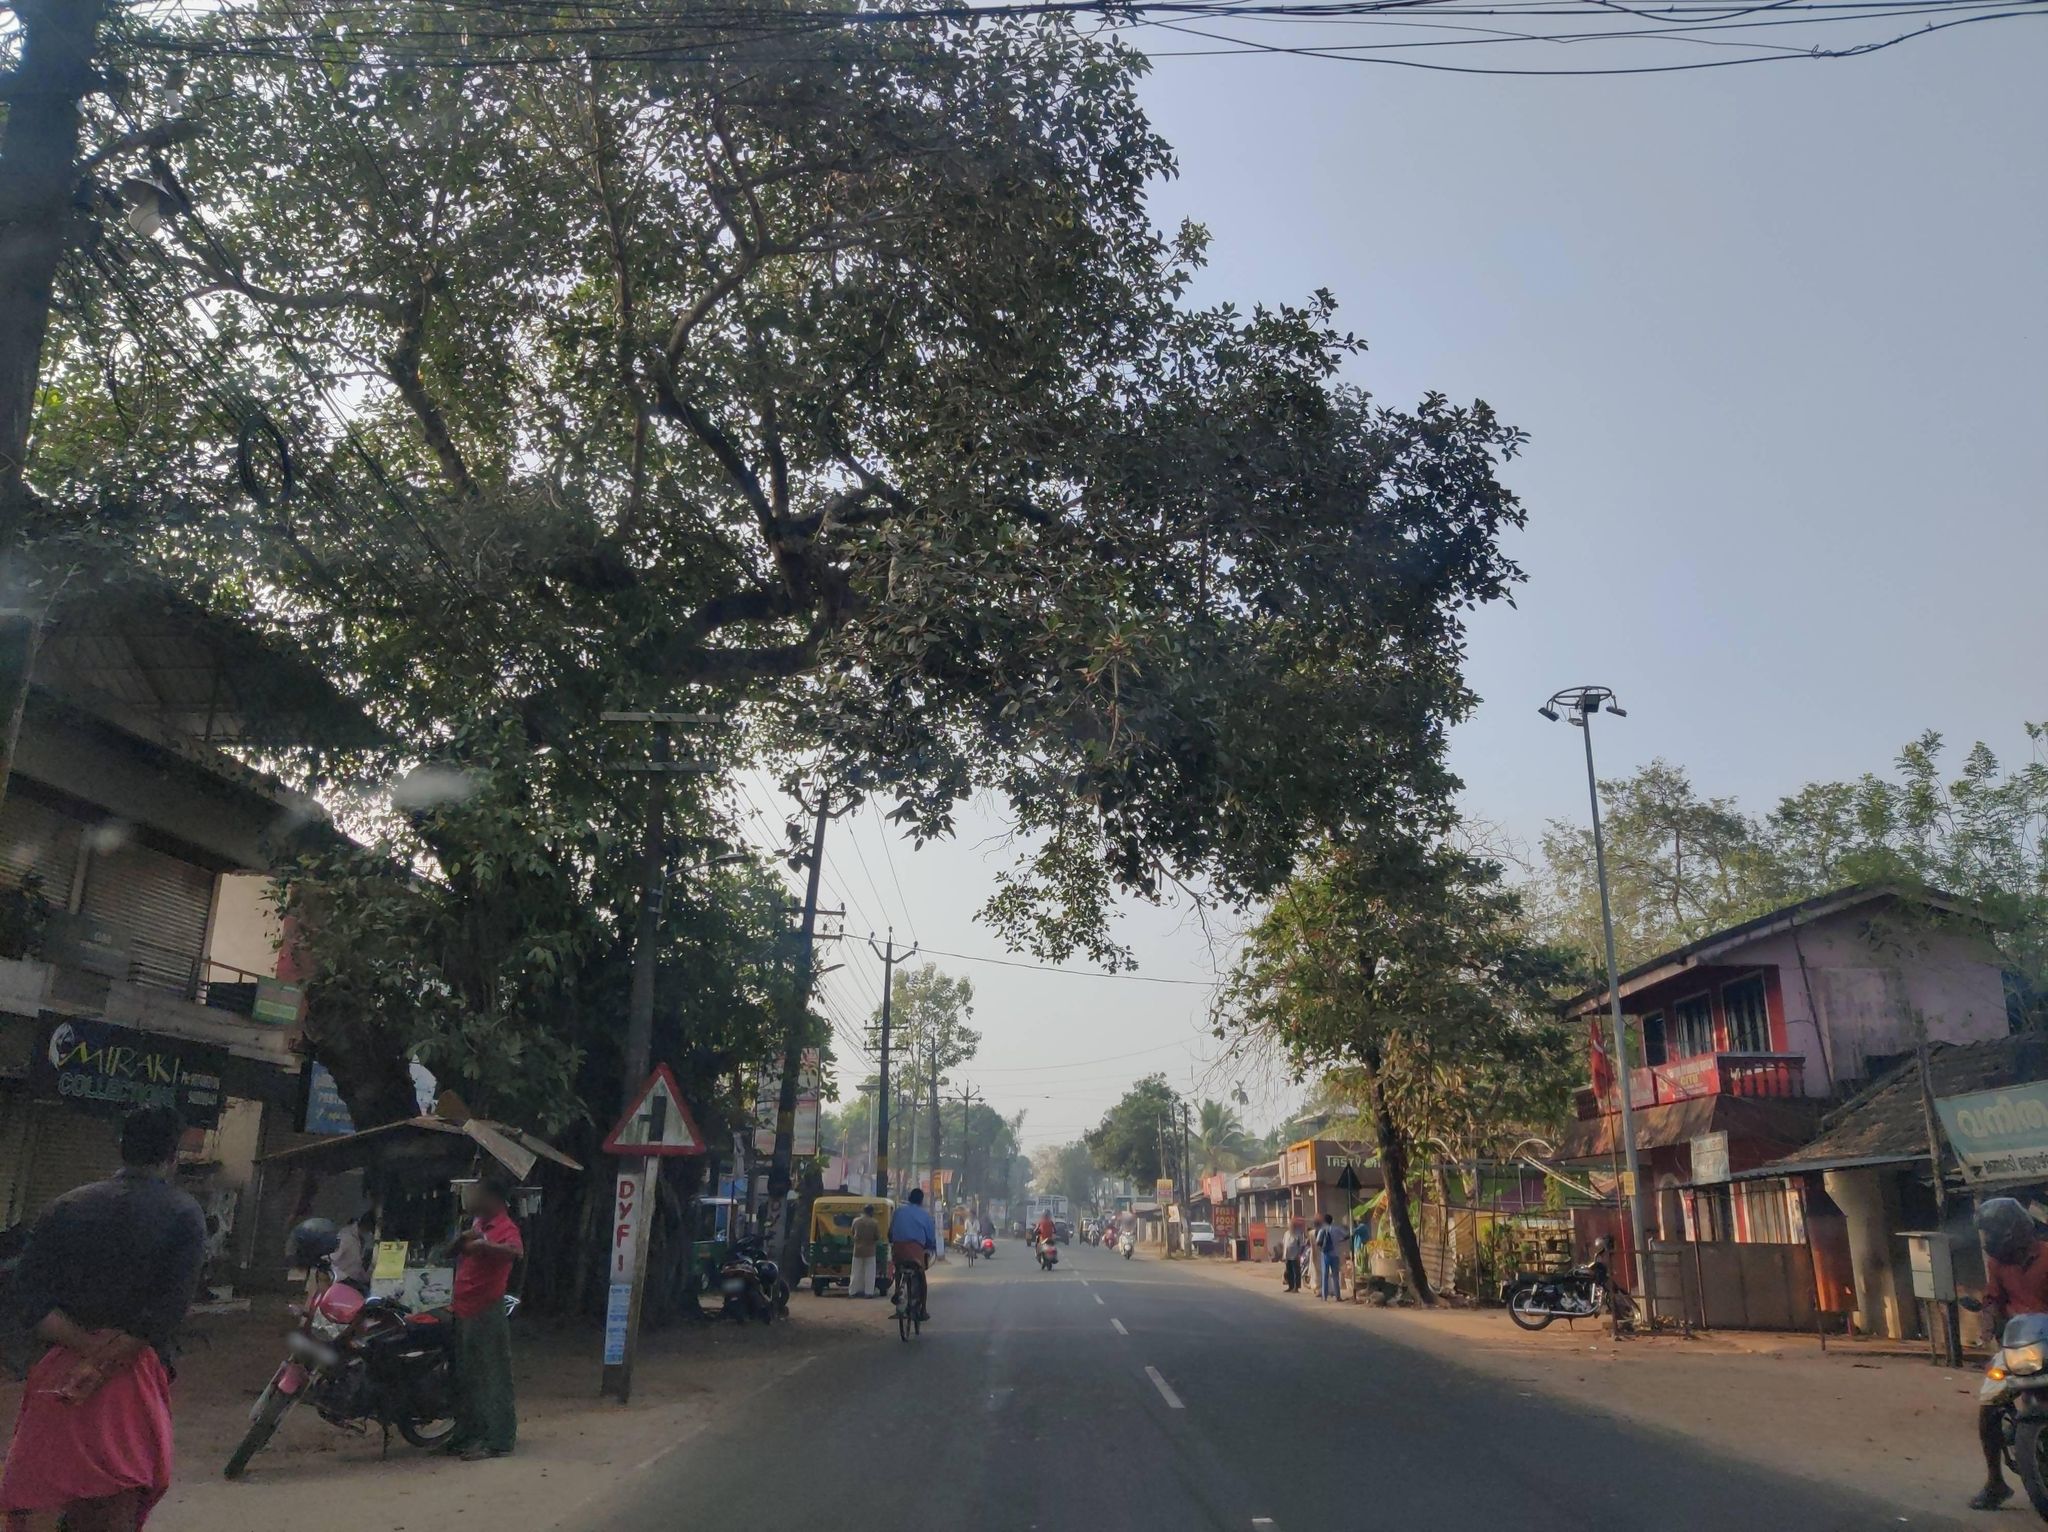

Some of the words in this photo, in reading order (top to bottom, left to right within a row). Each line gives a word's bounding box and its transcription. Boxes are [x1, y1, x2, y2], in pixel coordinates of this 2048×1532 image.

[57, 1042, 179, 1085] MIRAKI
[1326, 1154, 1361, 1168] TASTY
[615, 1180, 635, 1272] DYFI
